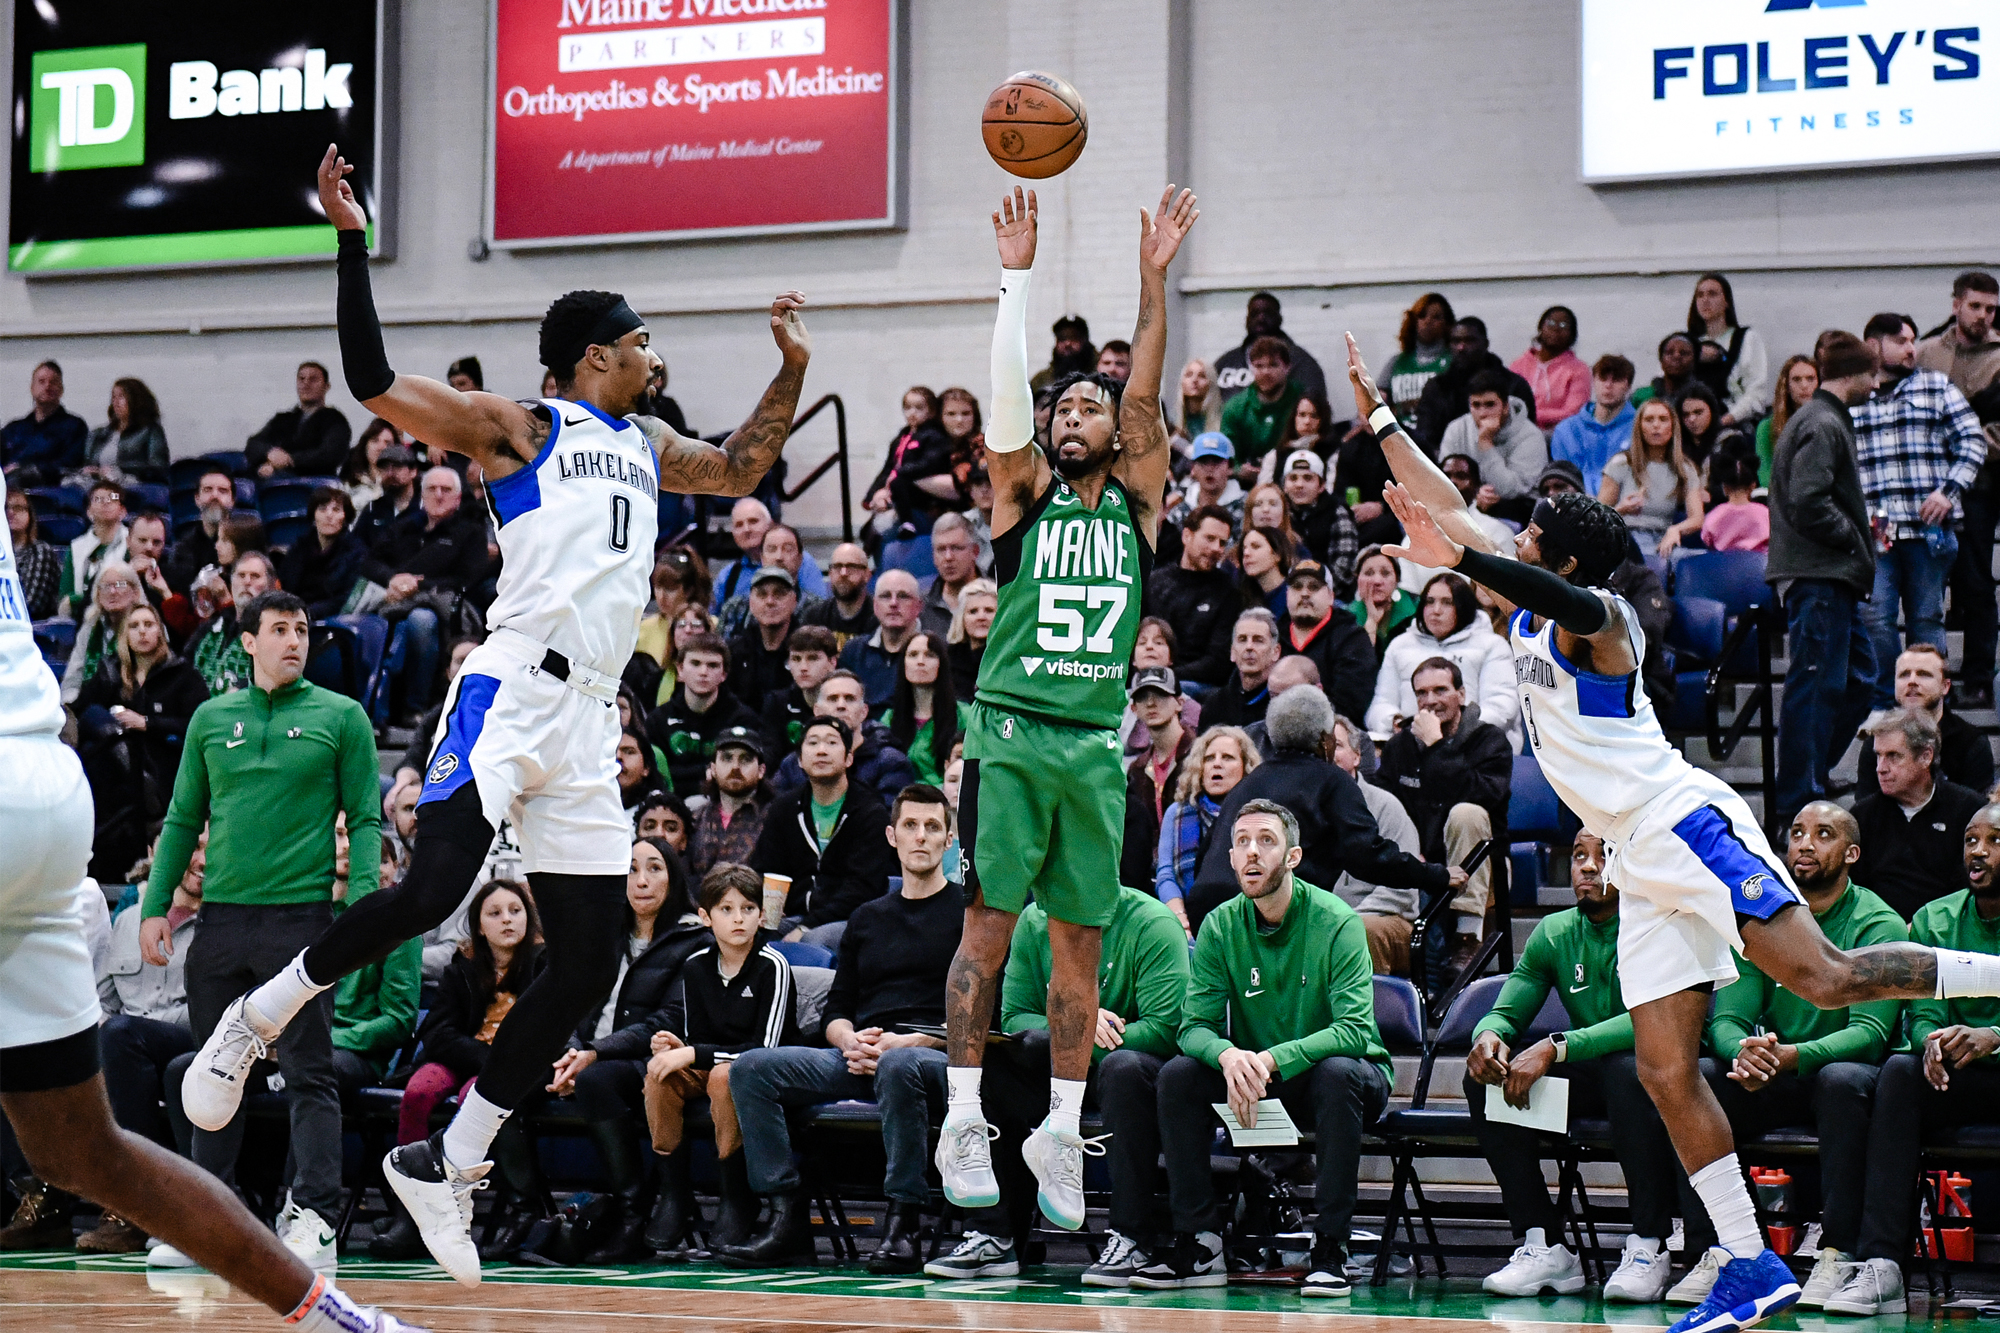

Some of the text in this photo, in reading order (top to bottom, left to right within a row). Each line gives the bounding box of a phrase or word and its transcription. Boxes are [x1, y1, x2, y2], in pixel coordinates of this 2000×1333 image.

[557, 0, 672, 28] Maine
[568, 26, 816, 64] PARTNERS
[1653, 26, 1980, 100] FOLEY'S
[41, 48, 353, 147] TD Bank
[503, 66, 884, 121] Orthopedics & Sports Medicine
[1716, 108, 1914, 136] FITNESS
[558, 137, 823, 173] A department of Maine Medical Center
[1391, 371, 1437, 404] MAIN
[555, 449, 658, 505] LAKELAND
[608, 491, 632, 554] 0
[1033, 519, 1133, 585] MAINE
[1036, 583, 1128, 654] 57
[1046, 659, 1124, 683] vistaprint
[1515, 653, 1558, 690] KELAND
